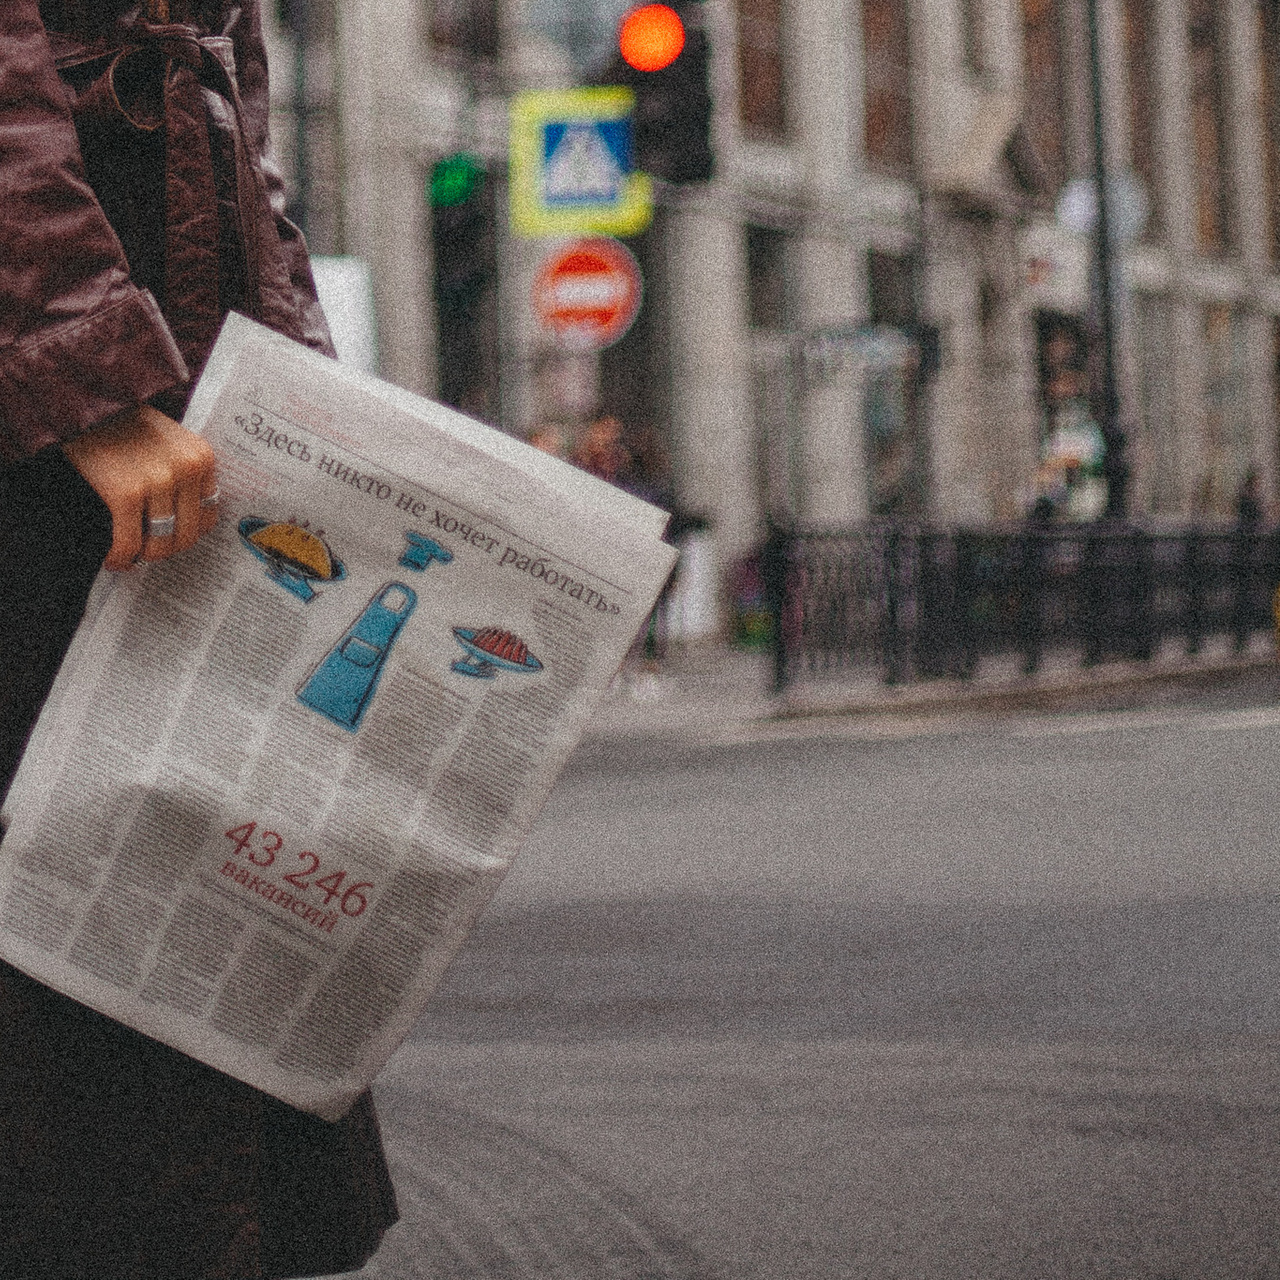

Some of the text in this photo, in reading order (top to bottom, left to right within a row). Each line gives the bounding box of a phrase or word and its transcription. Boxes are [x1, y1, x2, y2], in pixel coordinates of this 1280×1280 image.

[234, 412, 312, 463] «Здесь
[317, 453, 391, 500] никто
[395, 493, 426, 518] не
[430, 509, 500, 554] хочет
[498, 546, 621, 615] работать»
[220, 860, 339, 933] вакансий
[224, 821, 283, 867] 43
[282, 851, 374, 917] 246
